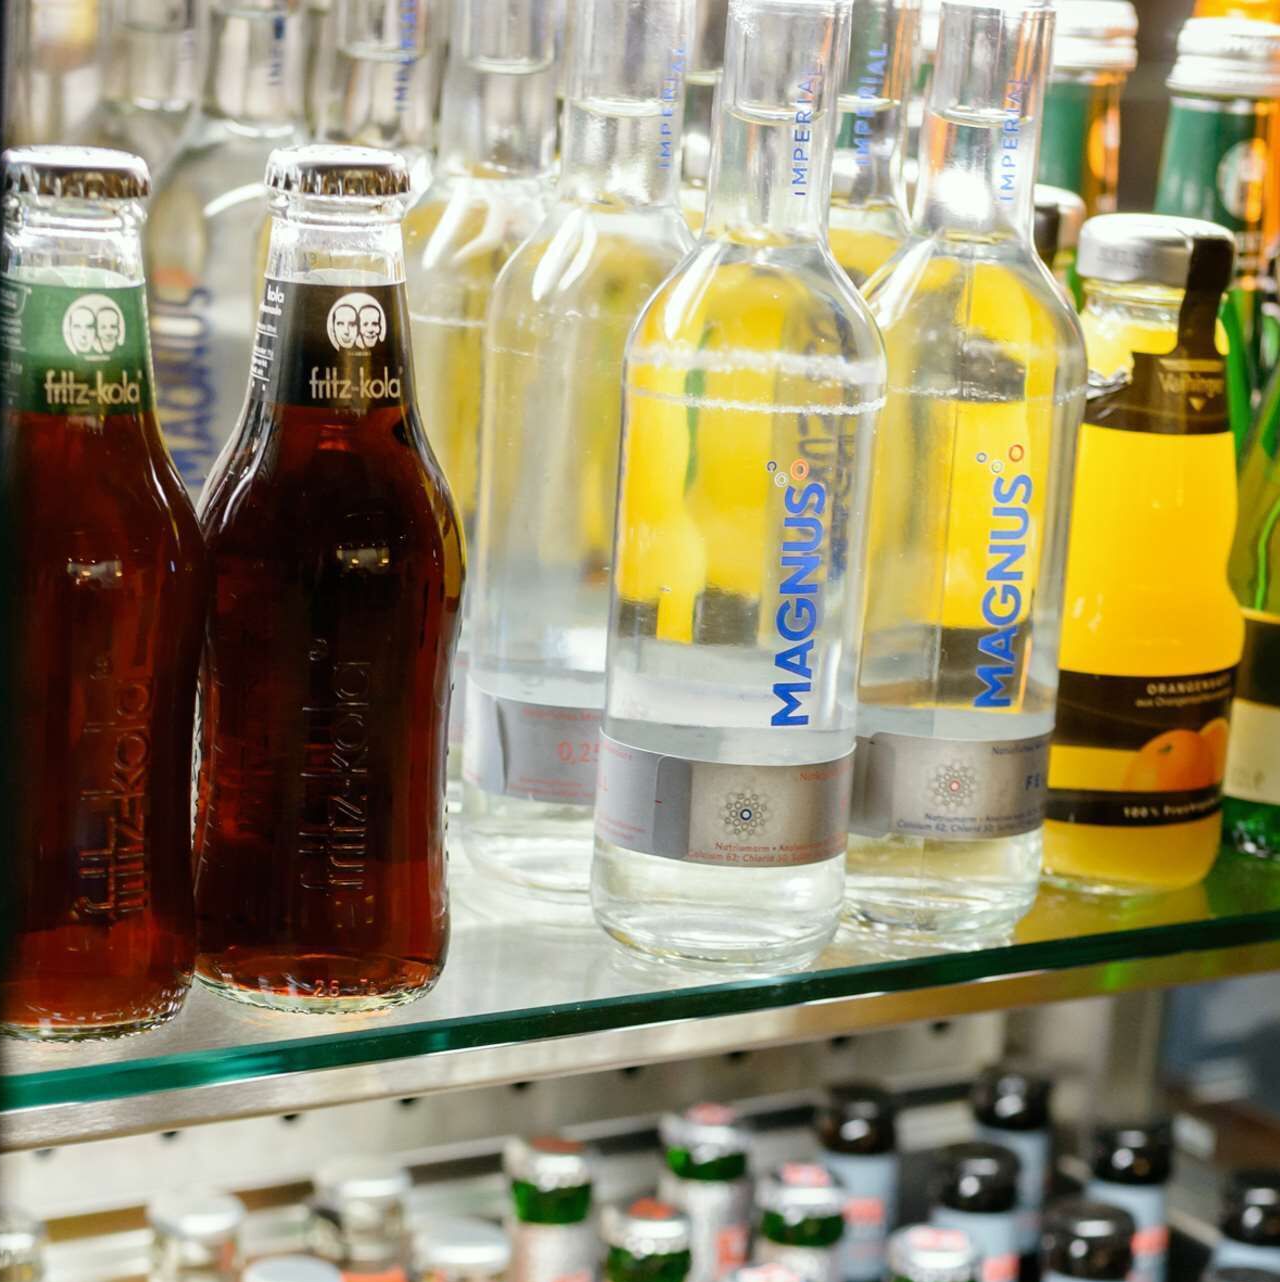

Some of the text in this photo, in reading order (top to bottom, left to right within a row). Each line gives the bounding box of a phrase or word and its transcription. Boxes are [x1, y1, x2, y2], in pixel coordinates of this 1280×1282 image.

[658, 40, 687, 170] IMPERIAL
[793, 61, 826, 197] IMPERIAL
[854, 41, 889, 167] IMPERIAL
[999, 72, 1034, 202] IMPERIAL
[44, 369, 142, 404] fritz-kola
[308, 365, 402, 400] fritz-kola
[770, 481, 827, 728] MAGNUS
[973, 472, 1034, 708] MAGNUS
